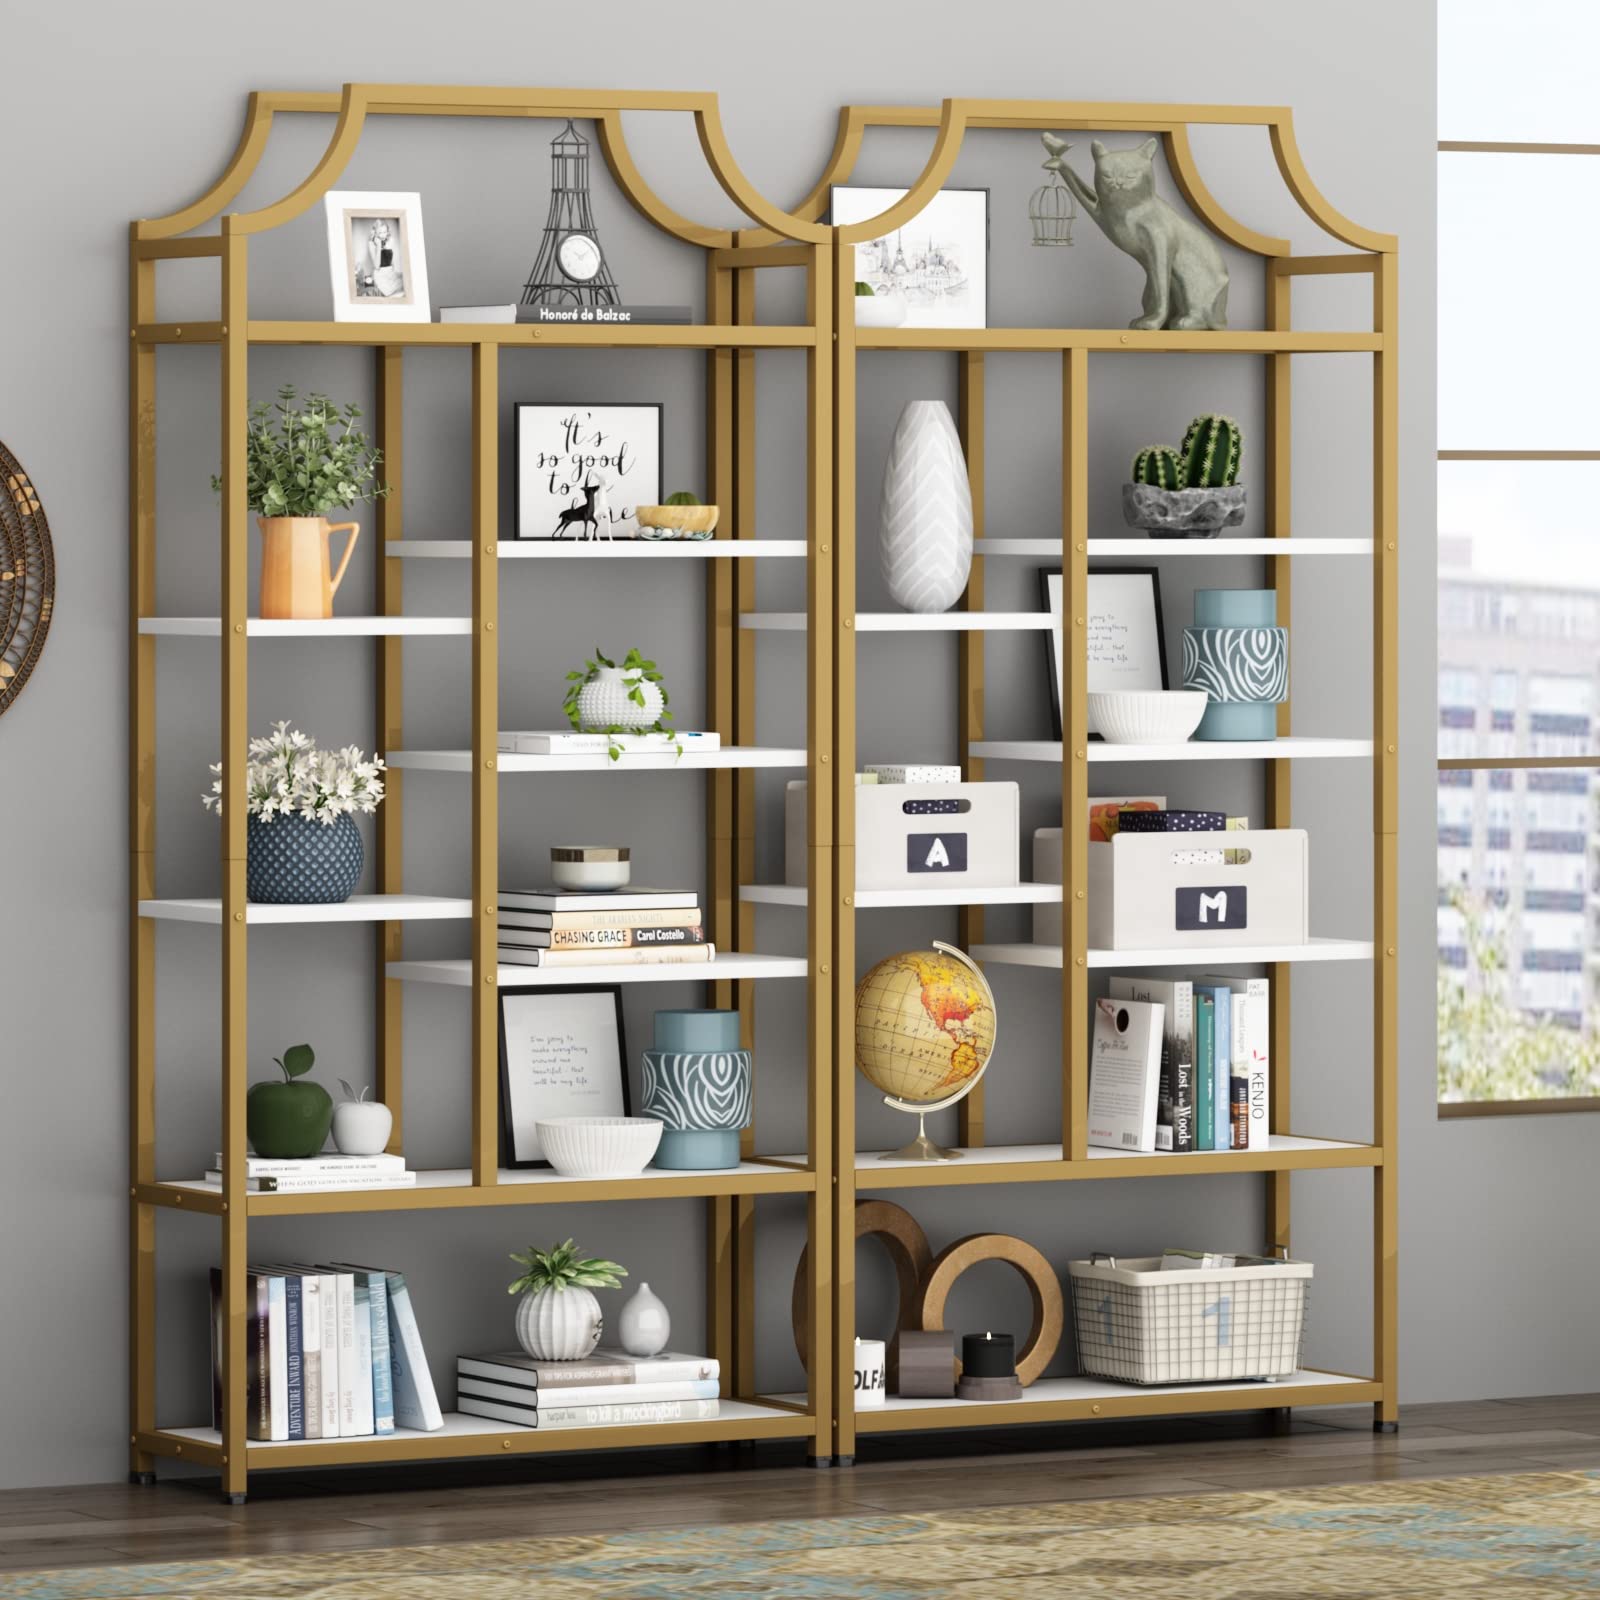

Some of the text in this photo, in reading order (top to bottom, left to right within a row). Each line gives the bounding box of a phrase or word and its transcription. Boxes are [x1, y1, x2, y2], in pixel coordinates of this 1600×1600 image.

[540, 307, 630, 321] Honoré de Balzac
[560, 412, 610, 453] It's
[537, 453, 565, 469] so
[571, 442, 636, 482] good
[547, 471, 577, 495] to
[925, 837, 950, 868] A
[1198, 890, 1228, 923] M
[554, 929, 628, 944] CHASING GRACE
[636, 928, 685, 942] Carol Costello
[1178, 1064, 1192, 1088] Lost
[1252, 1072, 1265, 1120] KENJO
[1178, 1106, 1192, 1145] Woods
[1201, 1296, 1230, 1346] 1
[288, 1355, 301, 1435] ADVENTURE INWARD
